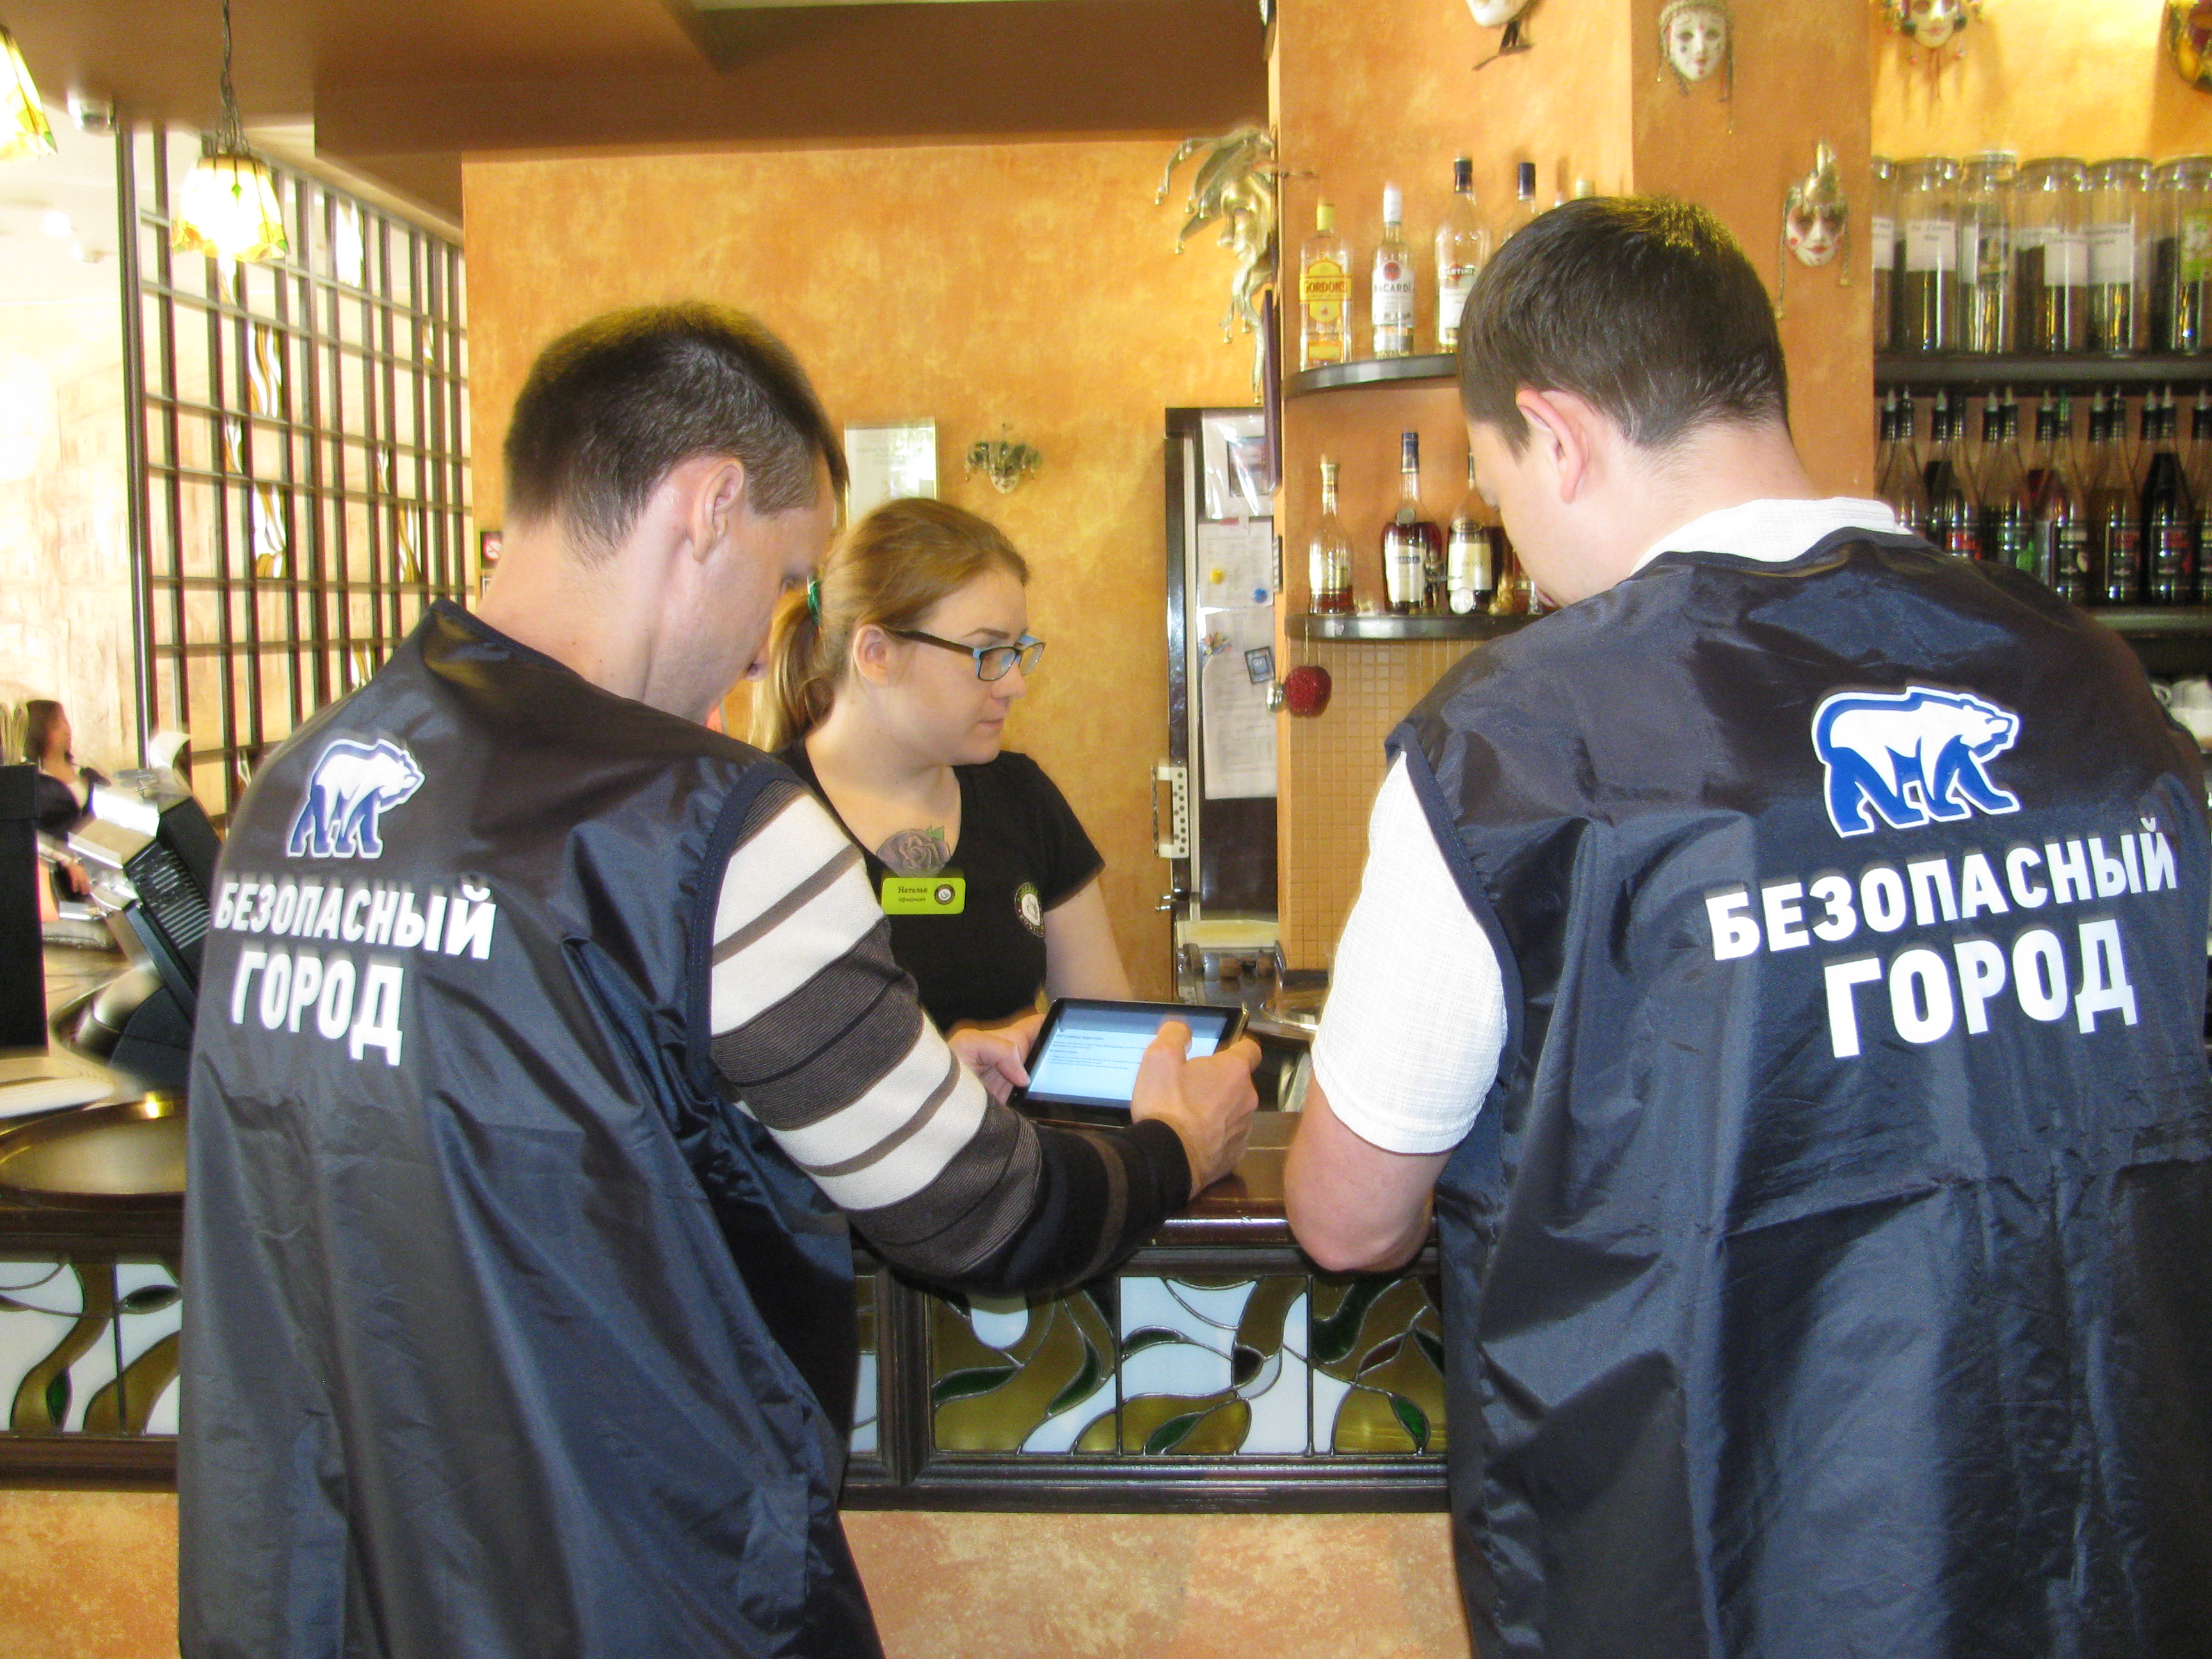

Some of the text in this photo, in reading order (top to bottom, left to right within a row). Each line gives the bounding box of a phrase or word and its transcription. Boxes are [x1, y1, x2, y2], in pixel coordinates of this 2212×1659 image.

[214, 881, 497, 960] БЕЗОПАСНЫЙ
[1705, 817, 2177, 961] БЕЗОПАСНЫЙ
[232, 949, 405, 1066] ГОРОД
[1823, 918, 2140, 1059] ГОРОД
